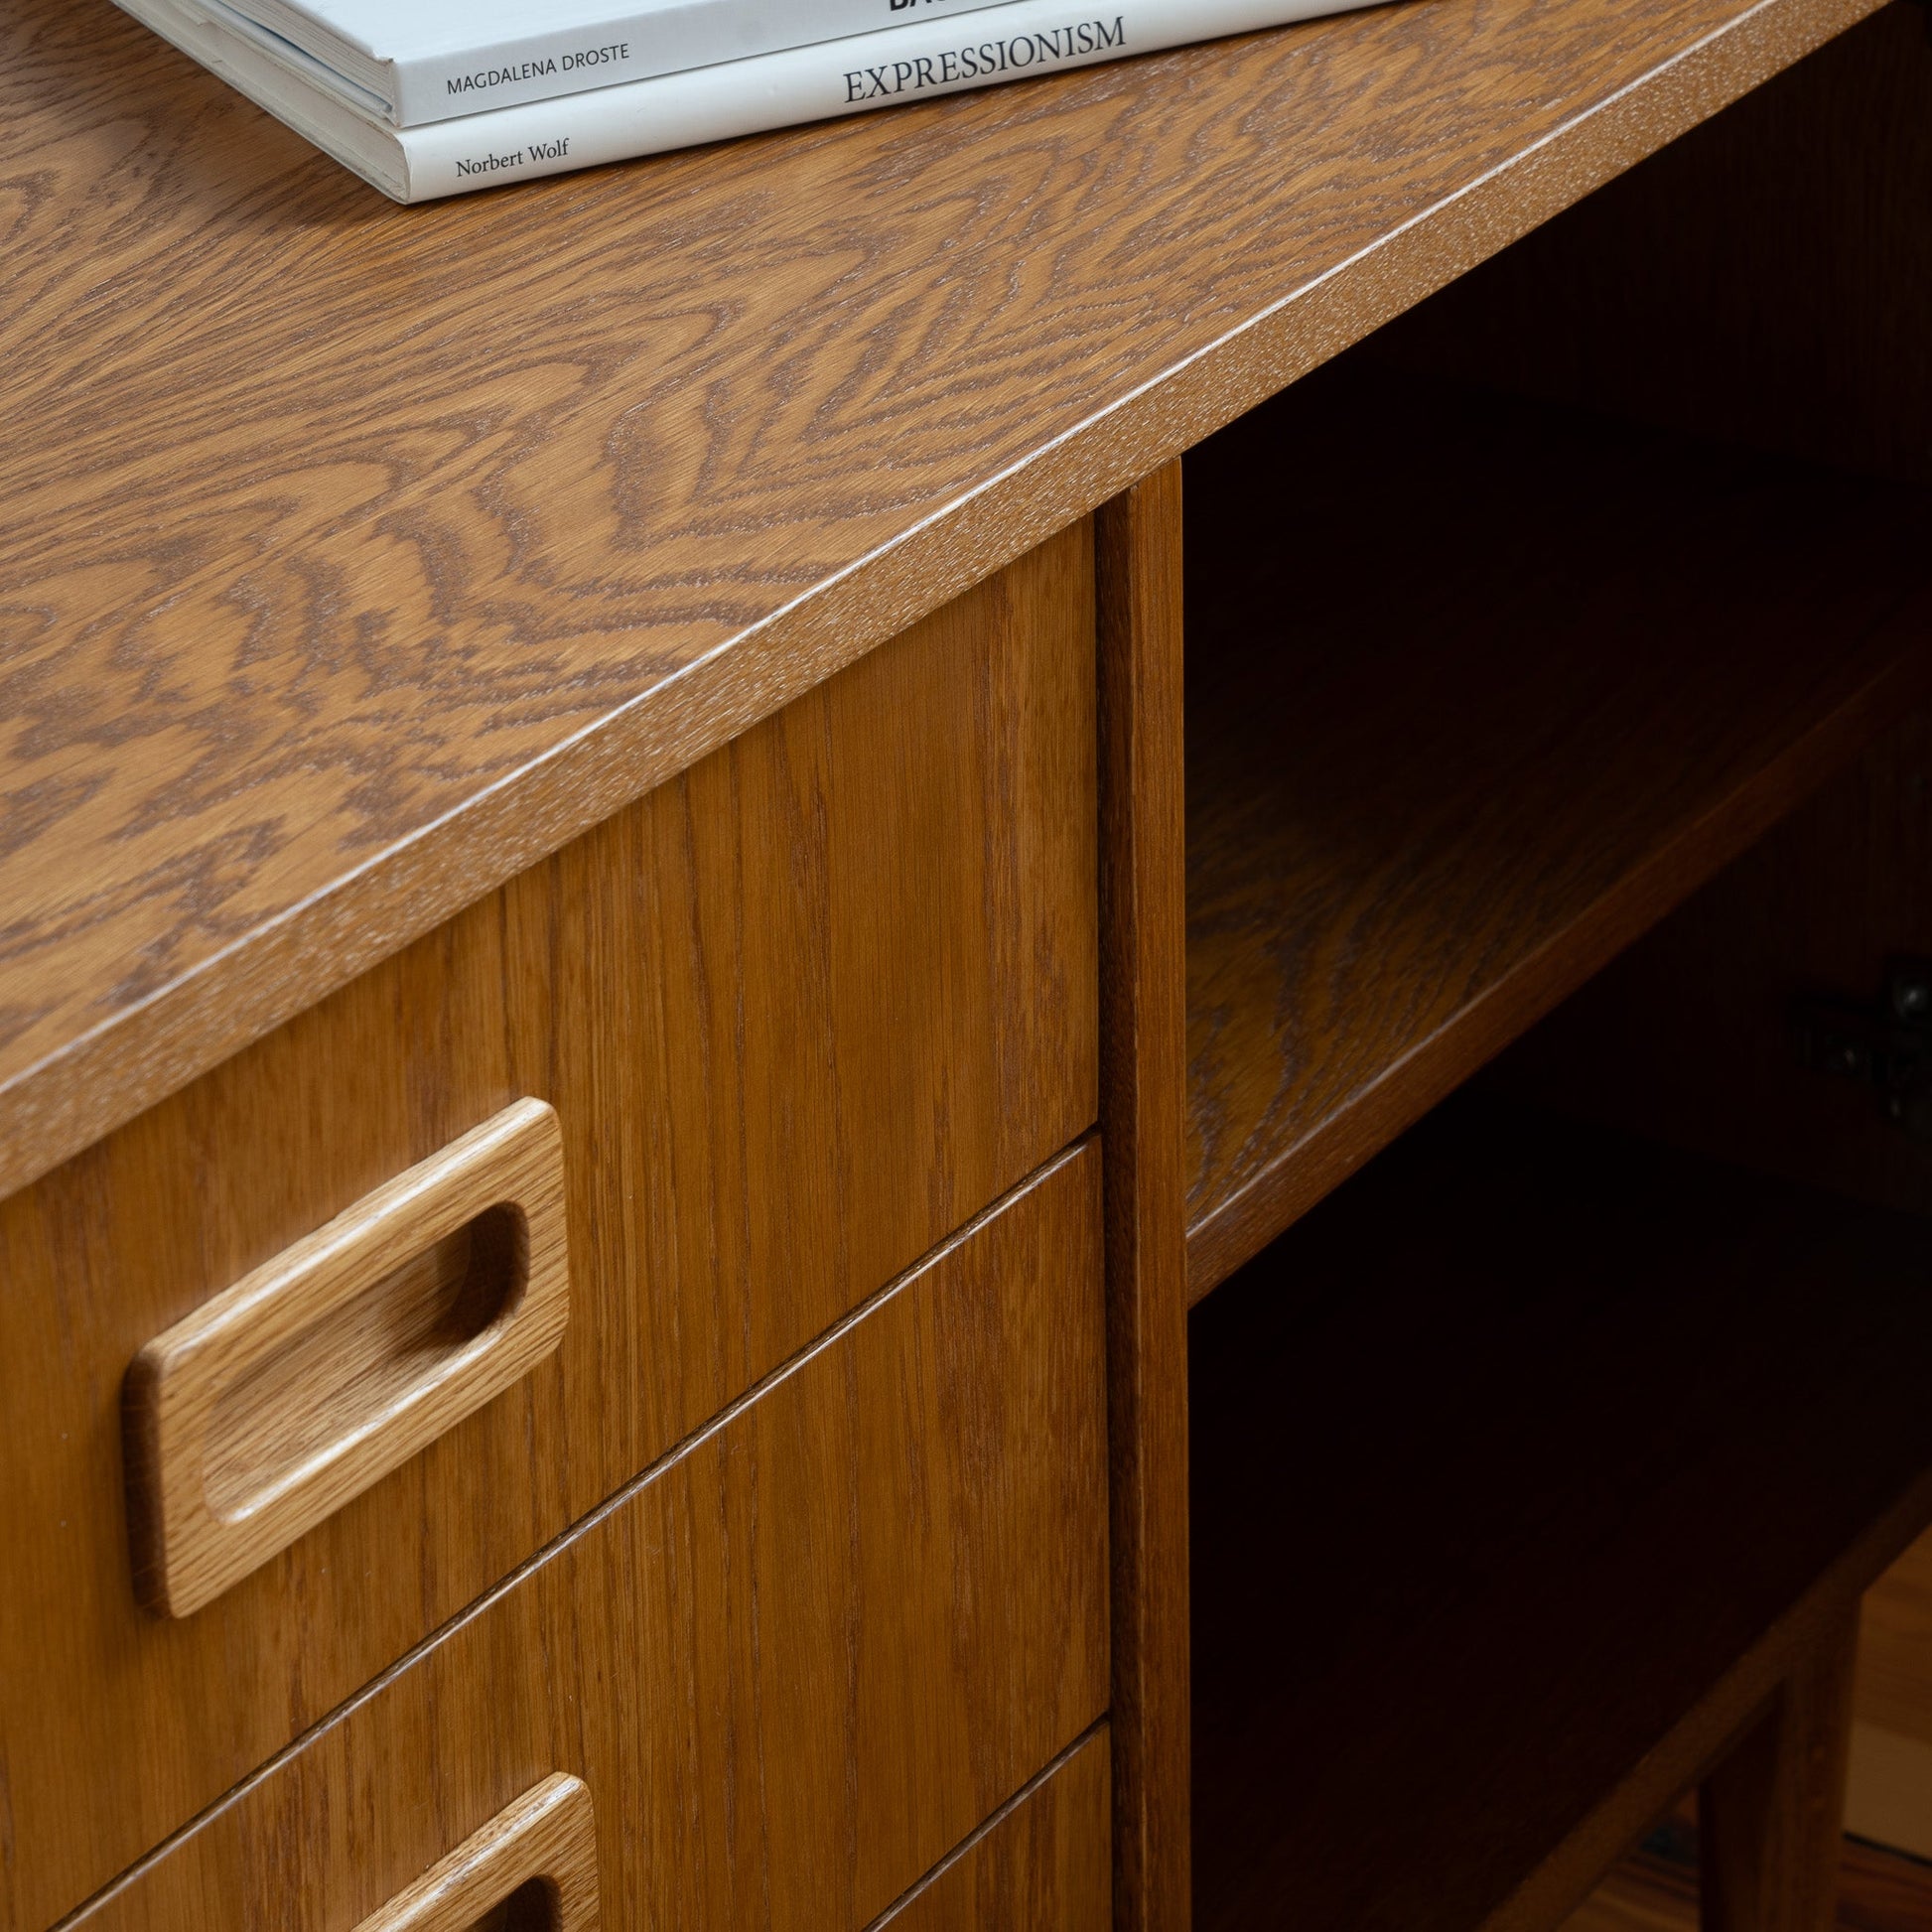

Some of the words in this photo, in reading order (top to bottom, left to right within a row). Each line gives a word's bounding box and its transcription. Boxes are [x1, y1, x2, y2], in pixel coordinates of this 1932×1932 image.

[447, 59, 557, 94] MAGDALENA
[562, 43, 629, 70] DROSTE
[843, 16, 1127, 103] EXPRESSIONISM
[456, 150, 523, 178] Norbert
[528, 138, 570, 160] Wolf
